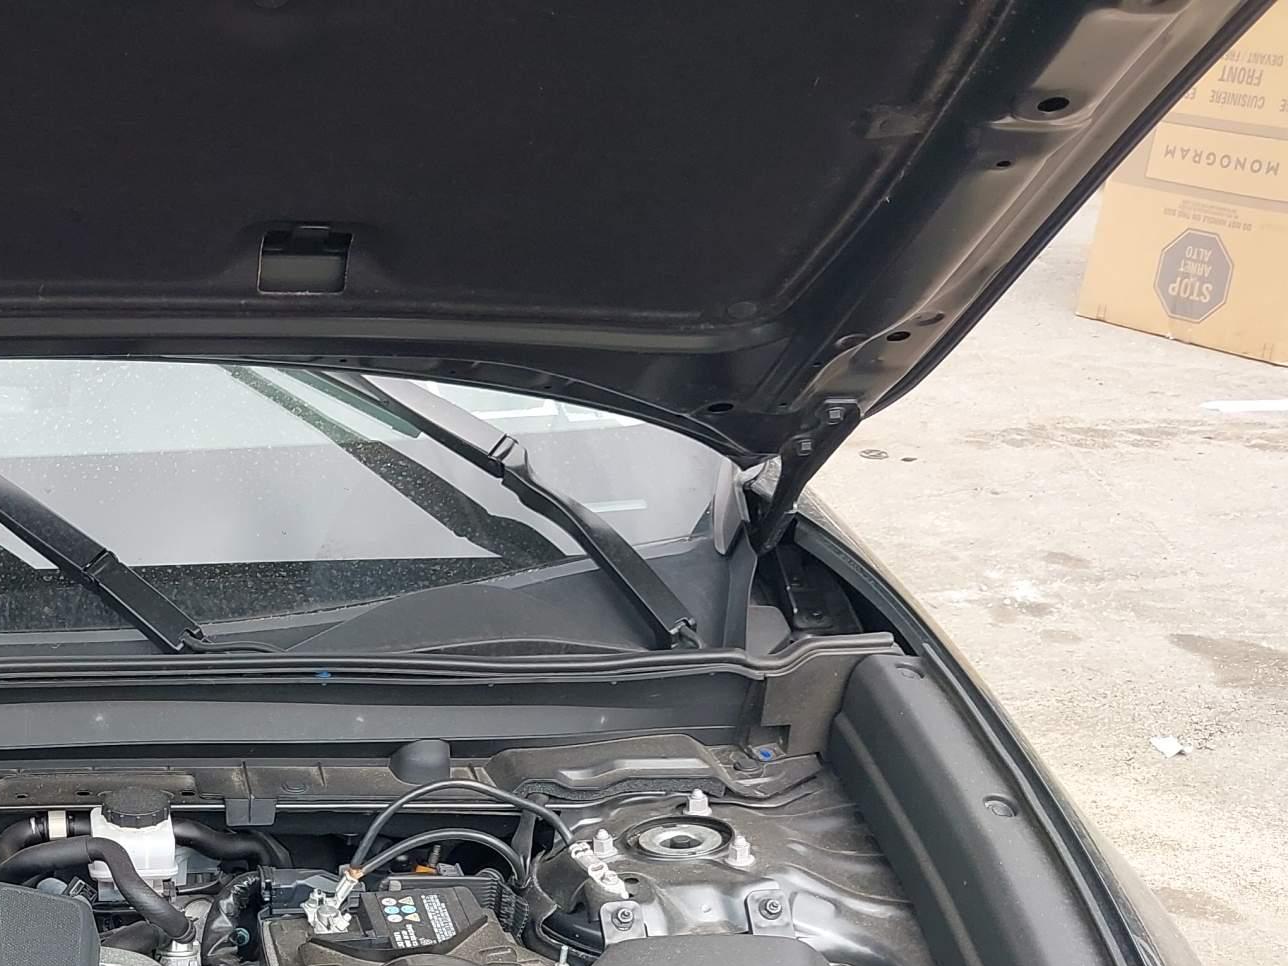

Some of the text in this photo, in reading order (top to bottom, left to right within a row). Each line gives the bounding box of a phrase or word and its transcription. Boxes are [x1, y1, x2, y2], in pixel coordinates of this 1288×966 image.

[1217, 64, 1265, 87] FRONT
[1164, 143, 1281, 176] MONOGRAM
[1185, 246, 1213, 262] ALTO
[1168, 277, 1213, 303] STOP
